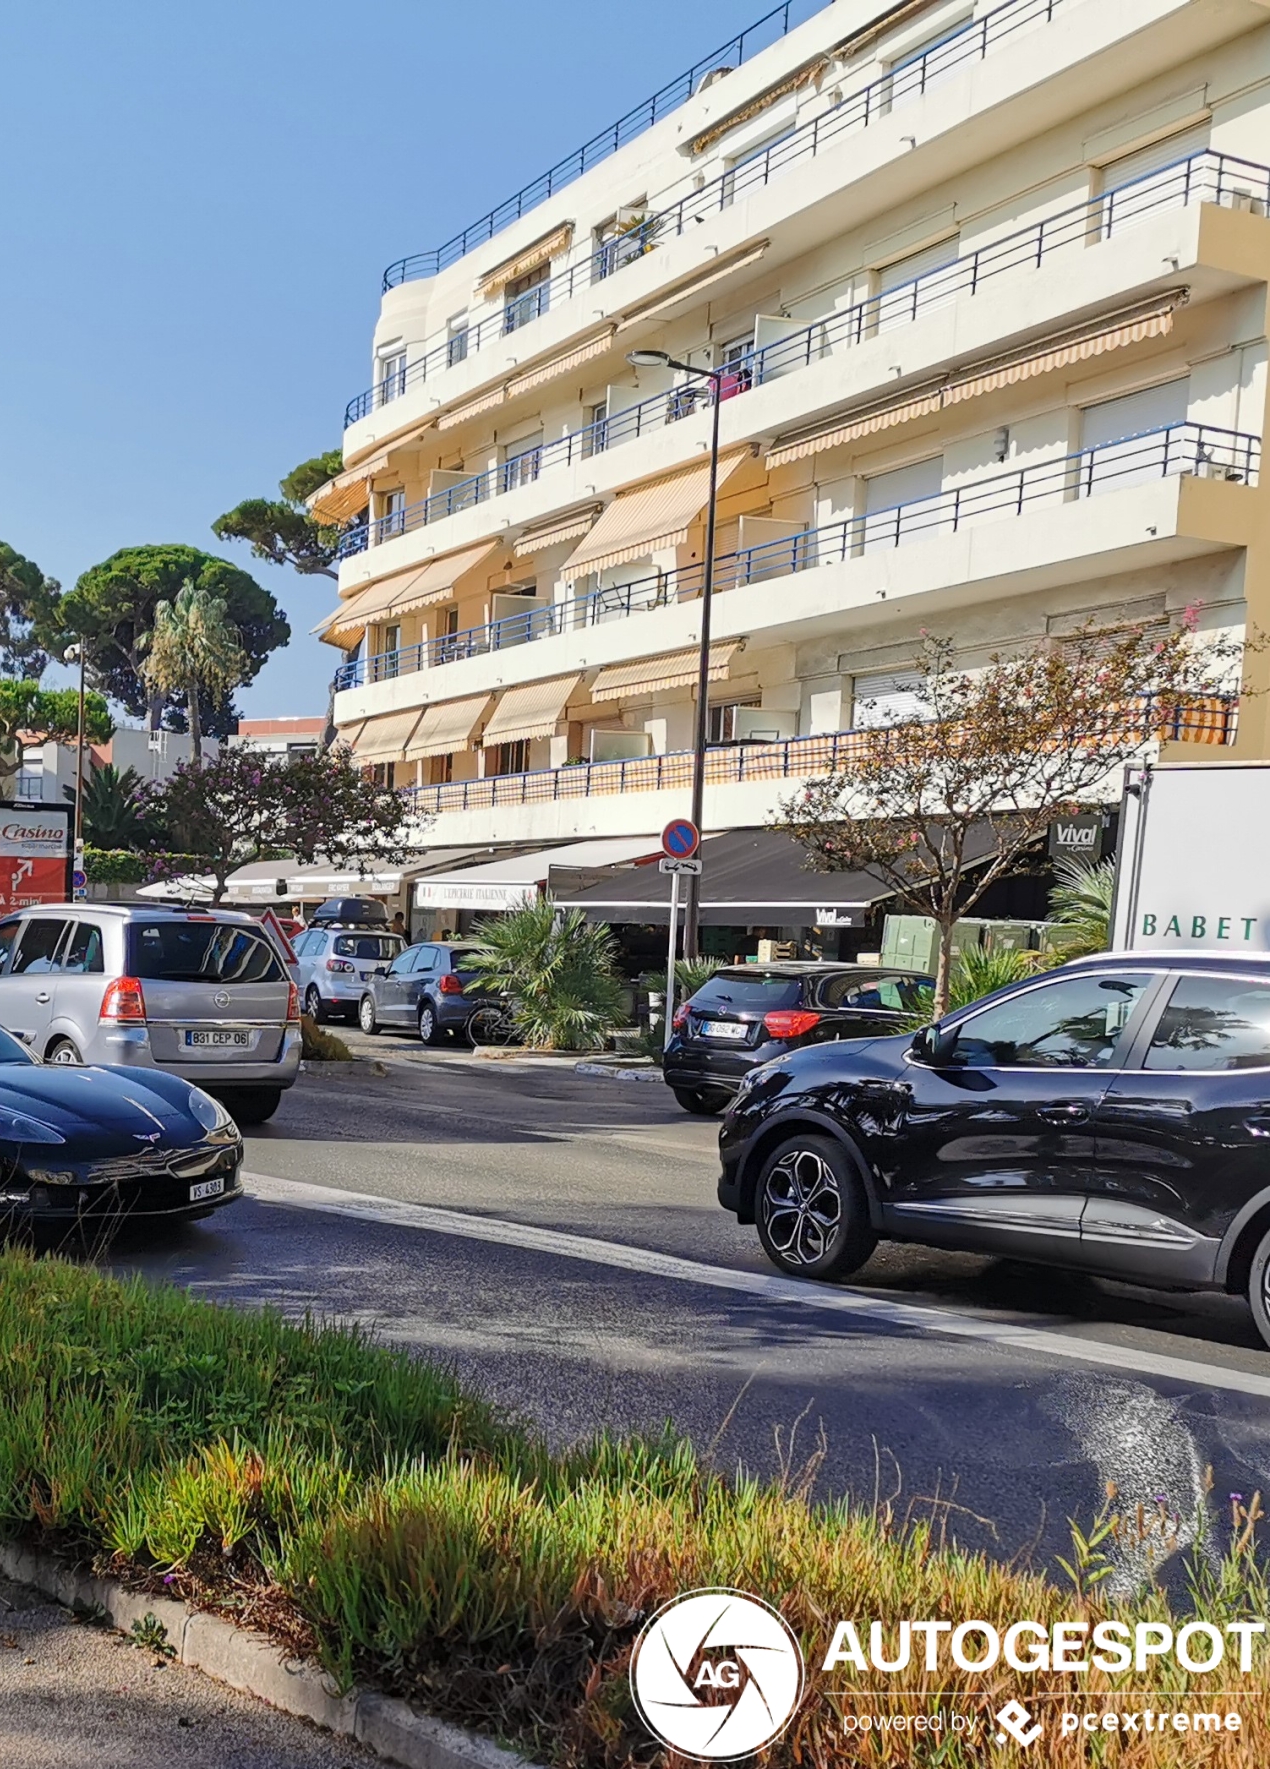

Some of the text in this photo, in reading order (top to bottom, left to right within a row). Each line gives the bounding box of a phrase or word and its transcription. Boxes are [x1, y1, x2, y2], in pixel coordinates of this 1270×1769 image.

[2, 824, 64, 840] Casino
[1056, 823, 1097, 844] Vival
[10, 896, 18, 905] 2
[193, 1032, 246, 1044] 831 CEP 06
[205, 1181, 221, 1195] 4303
